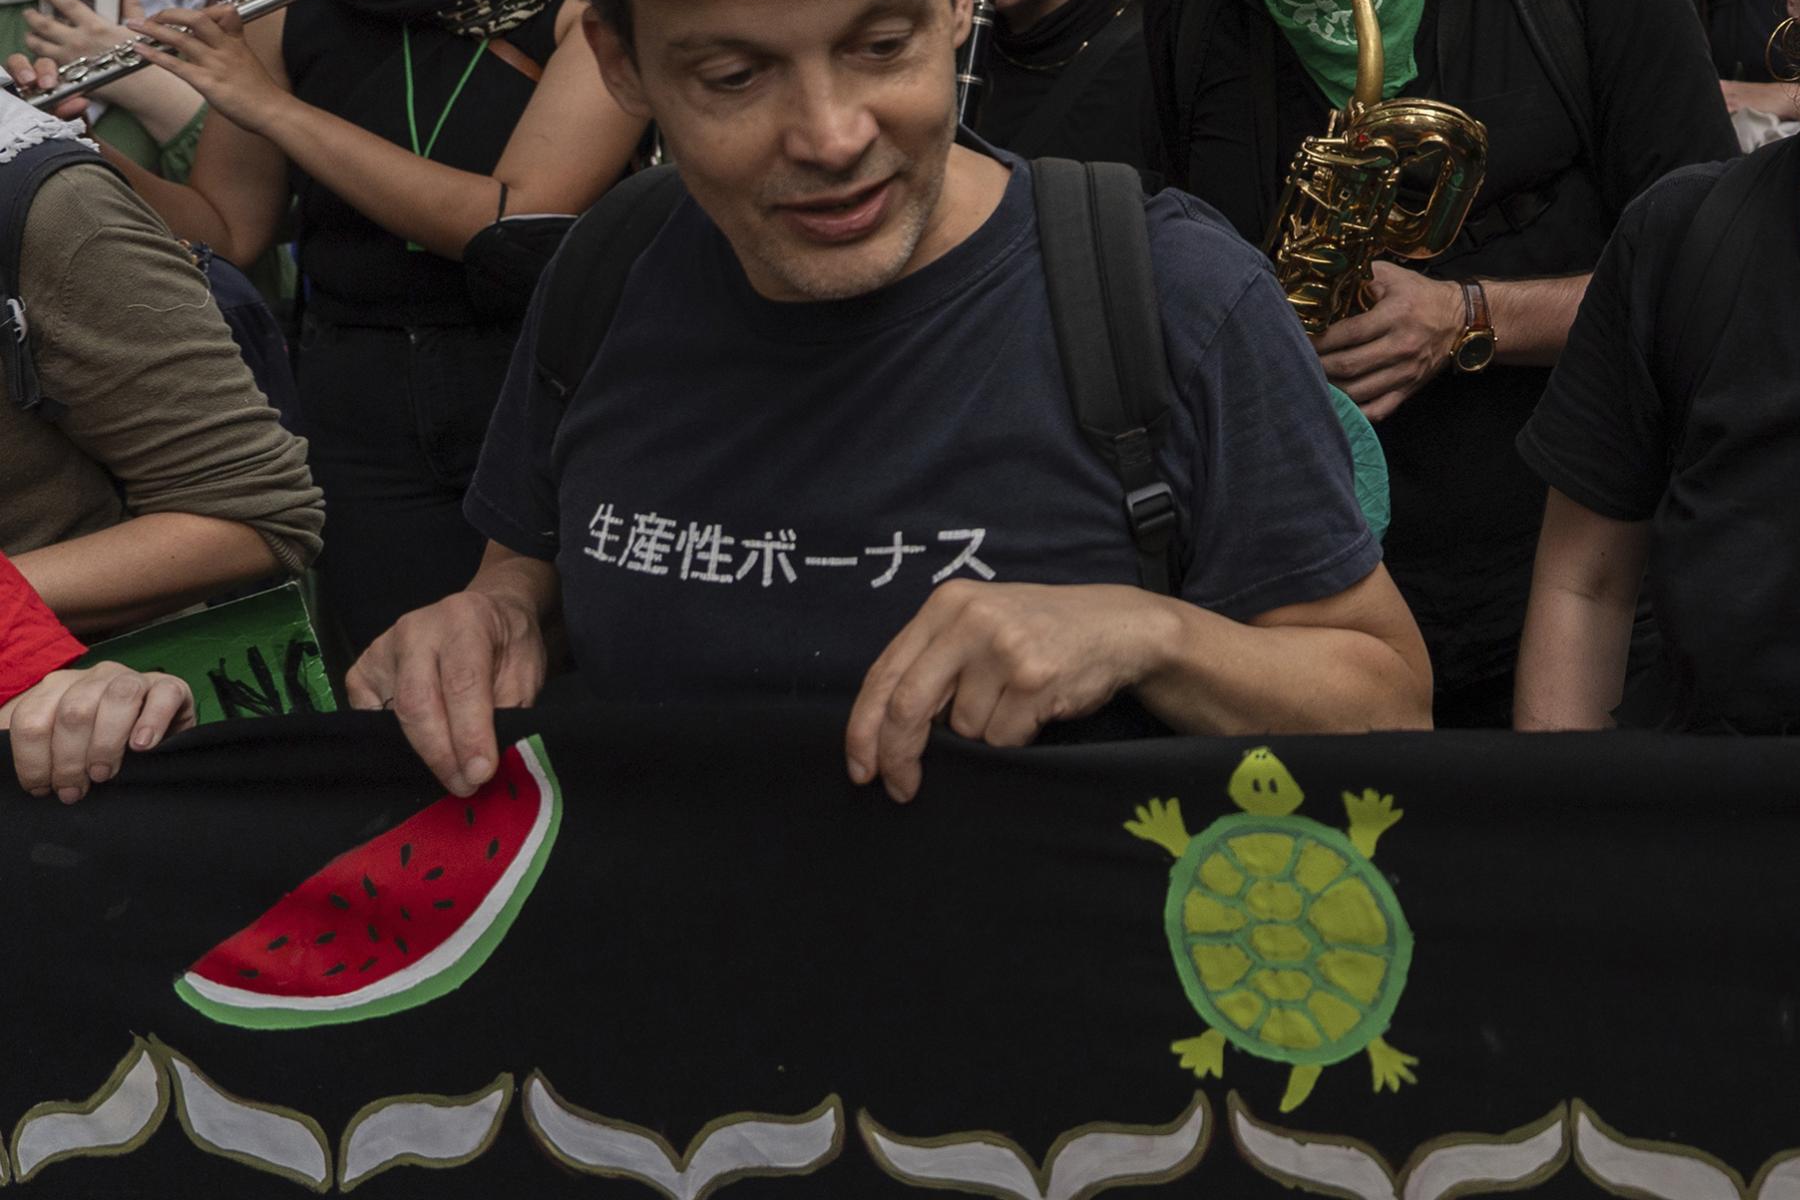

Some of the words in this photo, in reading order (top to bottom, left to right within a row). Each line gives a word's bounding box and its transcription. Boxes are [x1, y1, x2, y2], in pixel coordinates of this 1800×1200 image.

[583, 502, 997, 588] 生産性ボーナス
